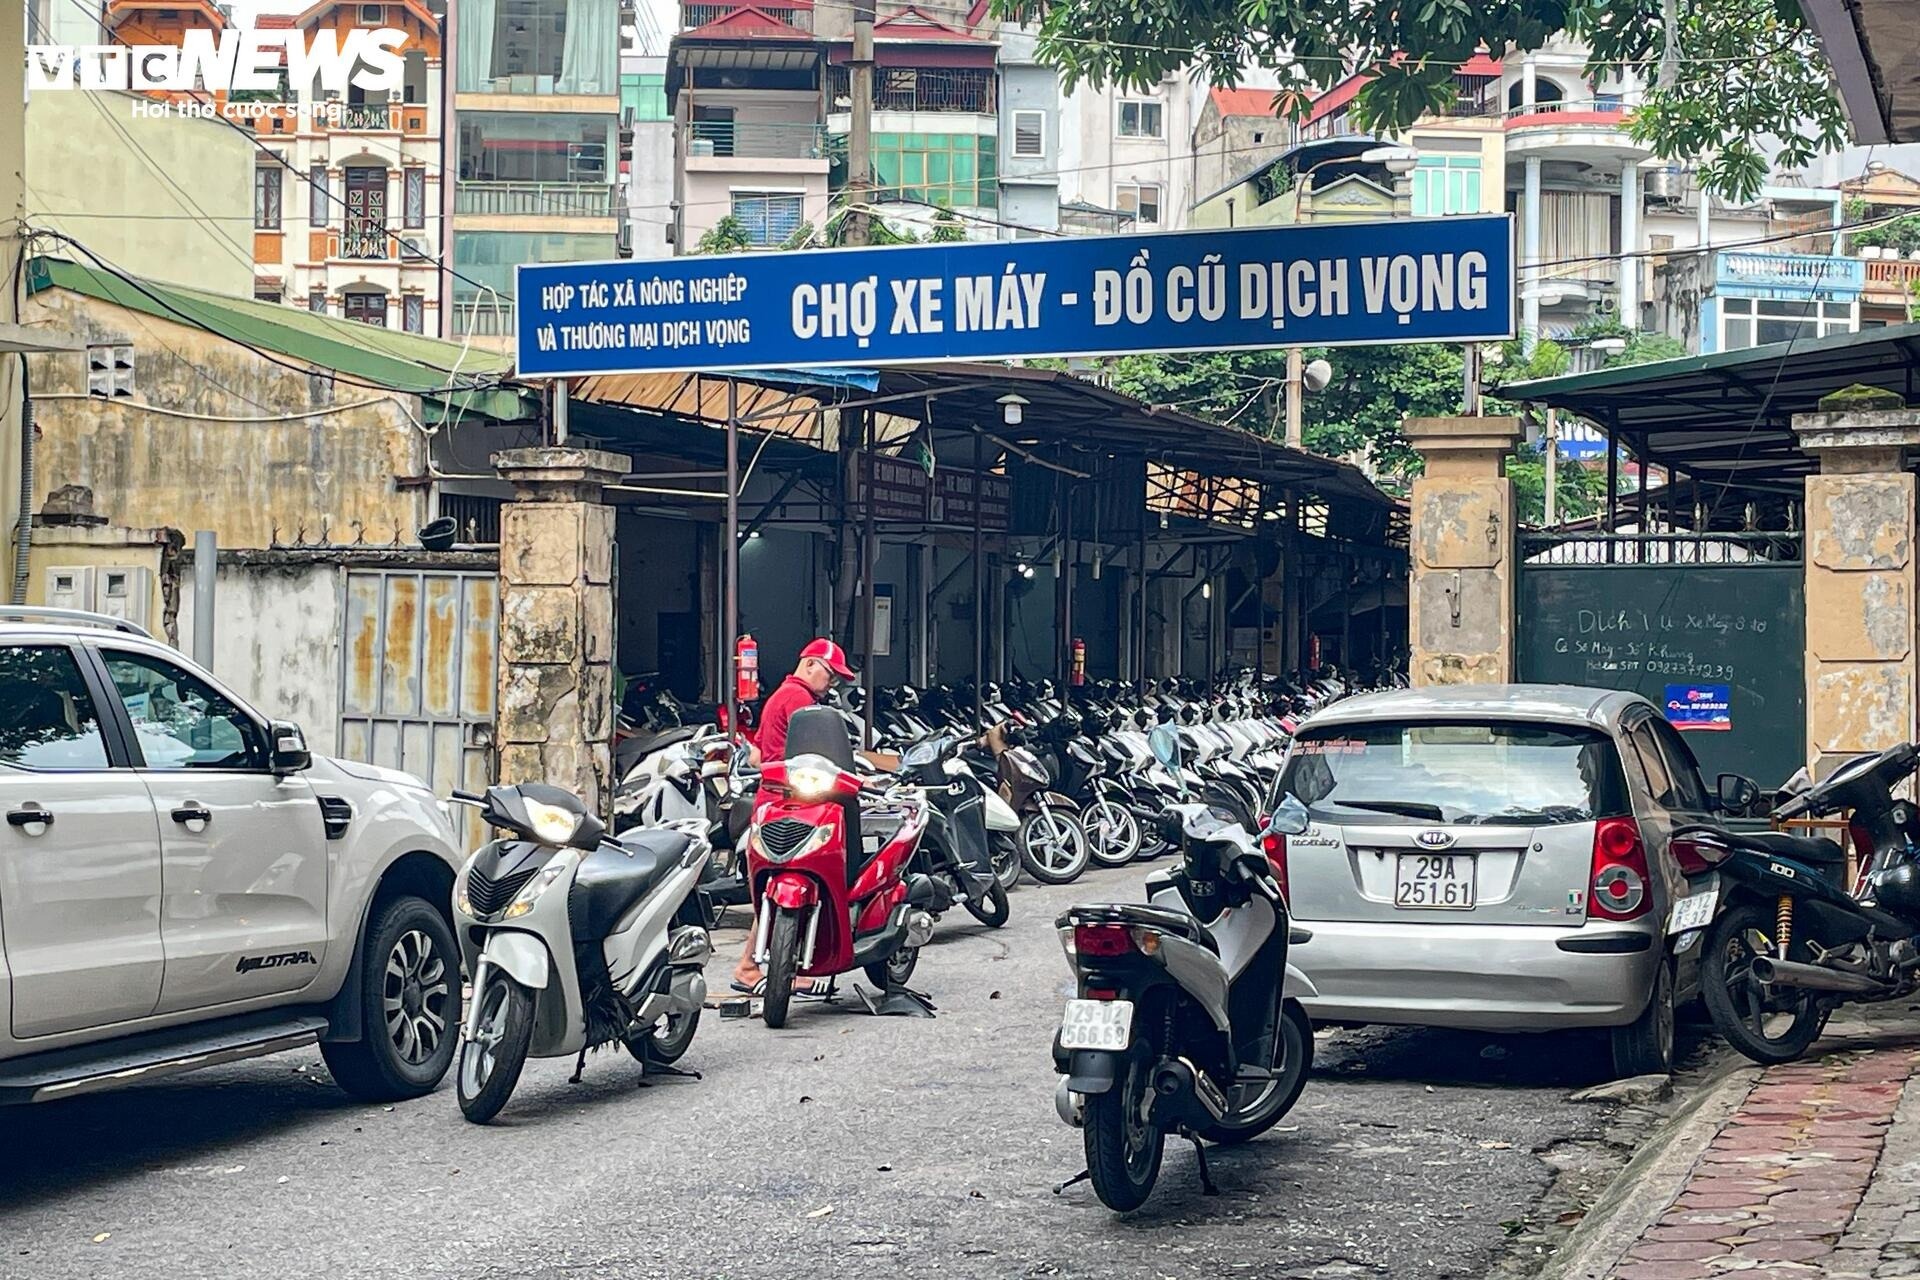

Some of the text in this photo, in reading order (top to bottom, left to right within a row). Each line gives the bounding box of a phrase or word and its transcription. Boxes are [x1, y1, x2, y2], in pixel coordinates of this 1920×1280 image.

[542, 272, 748, 313] HỢP TÁC XÃ NÔNG NGHIỆP
[792, 248, 1488, 348] CHỢ XE MÁY - ĐỒ CŨ DỊCH VỌNG
[537, 318, 750, 351] VÀ THƯƠNG MẠI DỊCH VỌNG
[1416, 856, 1455, 880] 29A
[1770, 862, 1795, 878] 100
[1399, 881, 1469, 905] 251.61
